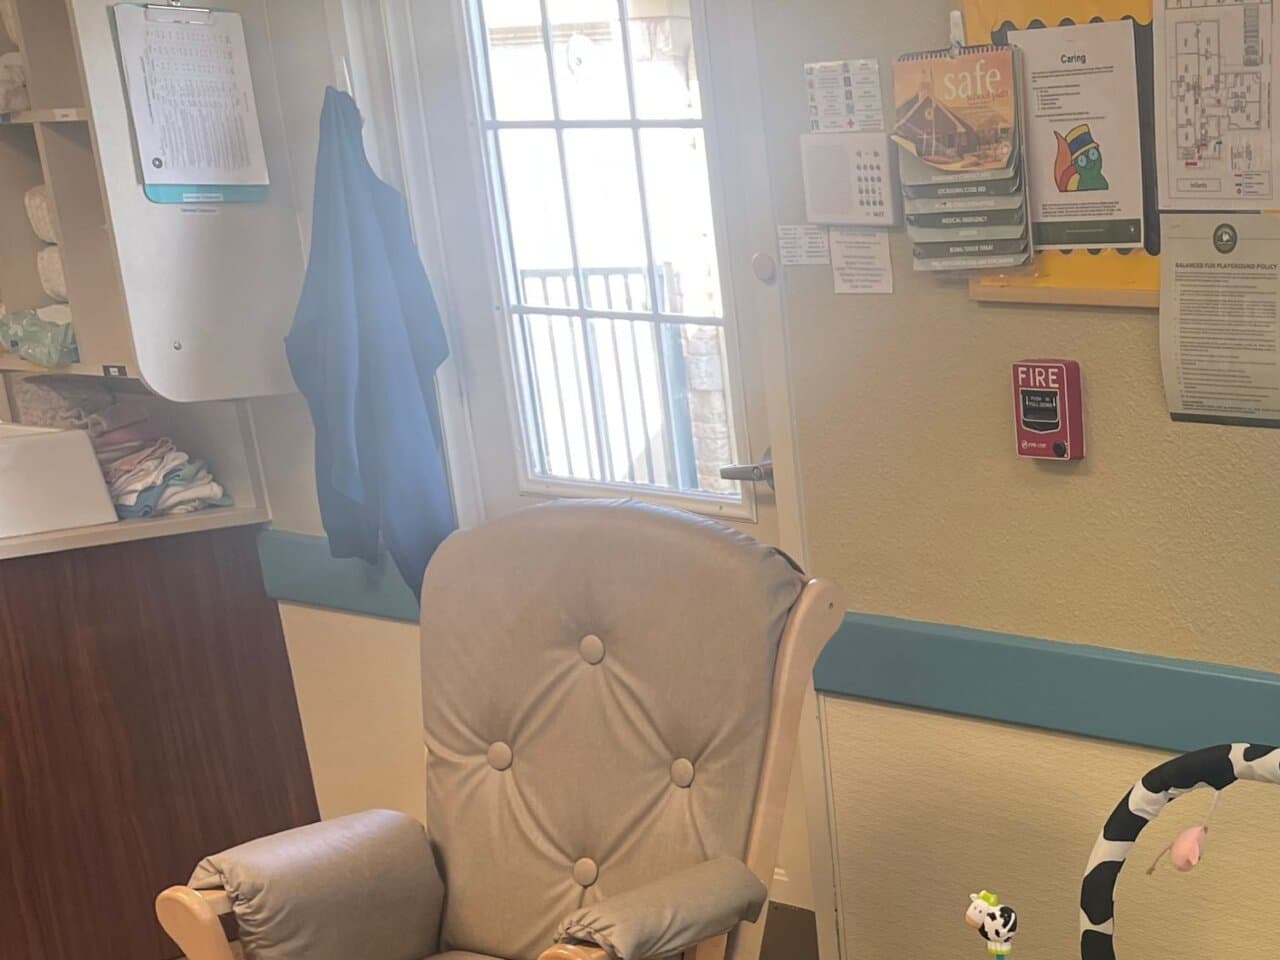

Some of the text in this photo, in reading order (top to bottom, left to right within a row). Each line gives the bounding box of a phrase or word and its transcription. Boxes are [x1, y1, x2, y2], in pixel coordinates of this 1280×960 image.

[1060, 53, 1087, 65] Caring
[943, 58, 1001, 100] safe
[1017, 367, 1060, 388] FIRE
